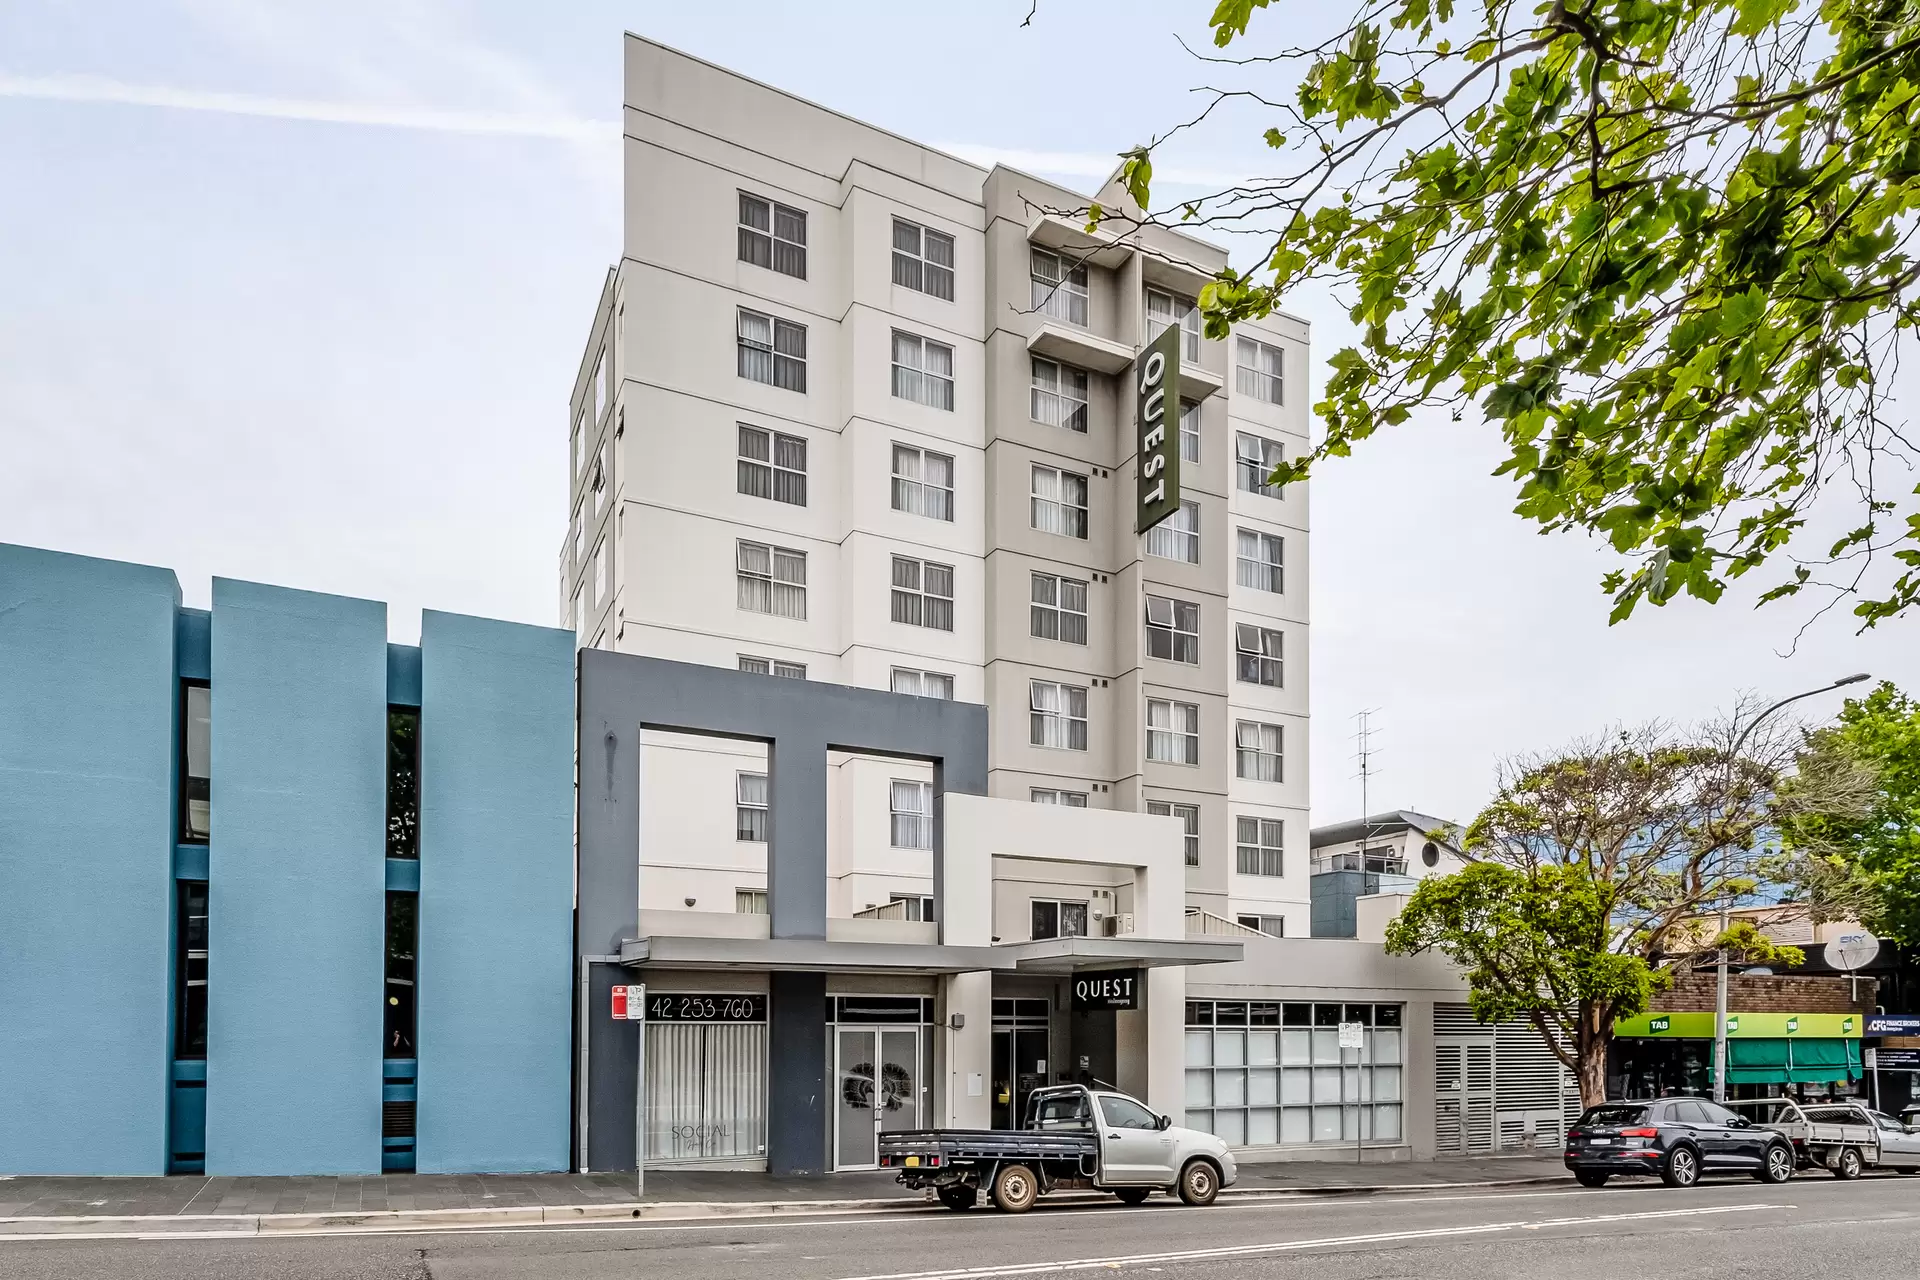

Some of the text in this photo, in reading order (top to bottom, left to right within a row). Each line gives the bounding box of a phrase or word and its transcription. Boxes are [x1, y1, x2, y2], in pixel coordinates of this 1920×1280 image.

[1140, 351, 1166, 505] QUEST
[1076, 978, 1133, 1002] QUEST
[651, 997, 673, 1018] 42
[680, 998, 716, 1018] 253
[723, 999, 753, 1018] 760
[1651, 1021, 1669, 1029] TAB
[1871, 1020, 1887, 1031] CFG
[671, 1124, 731, 1140] SOCIAL
